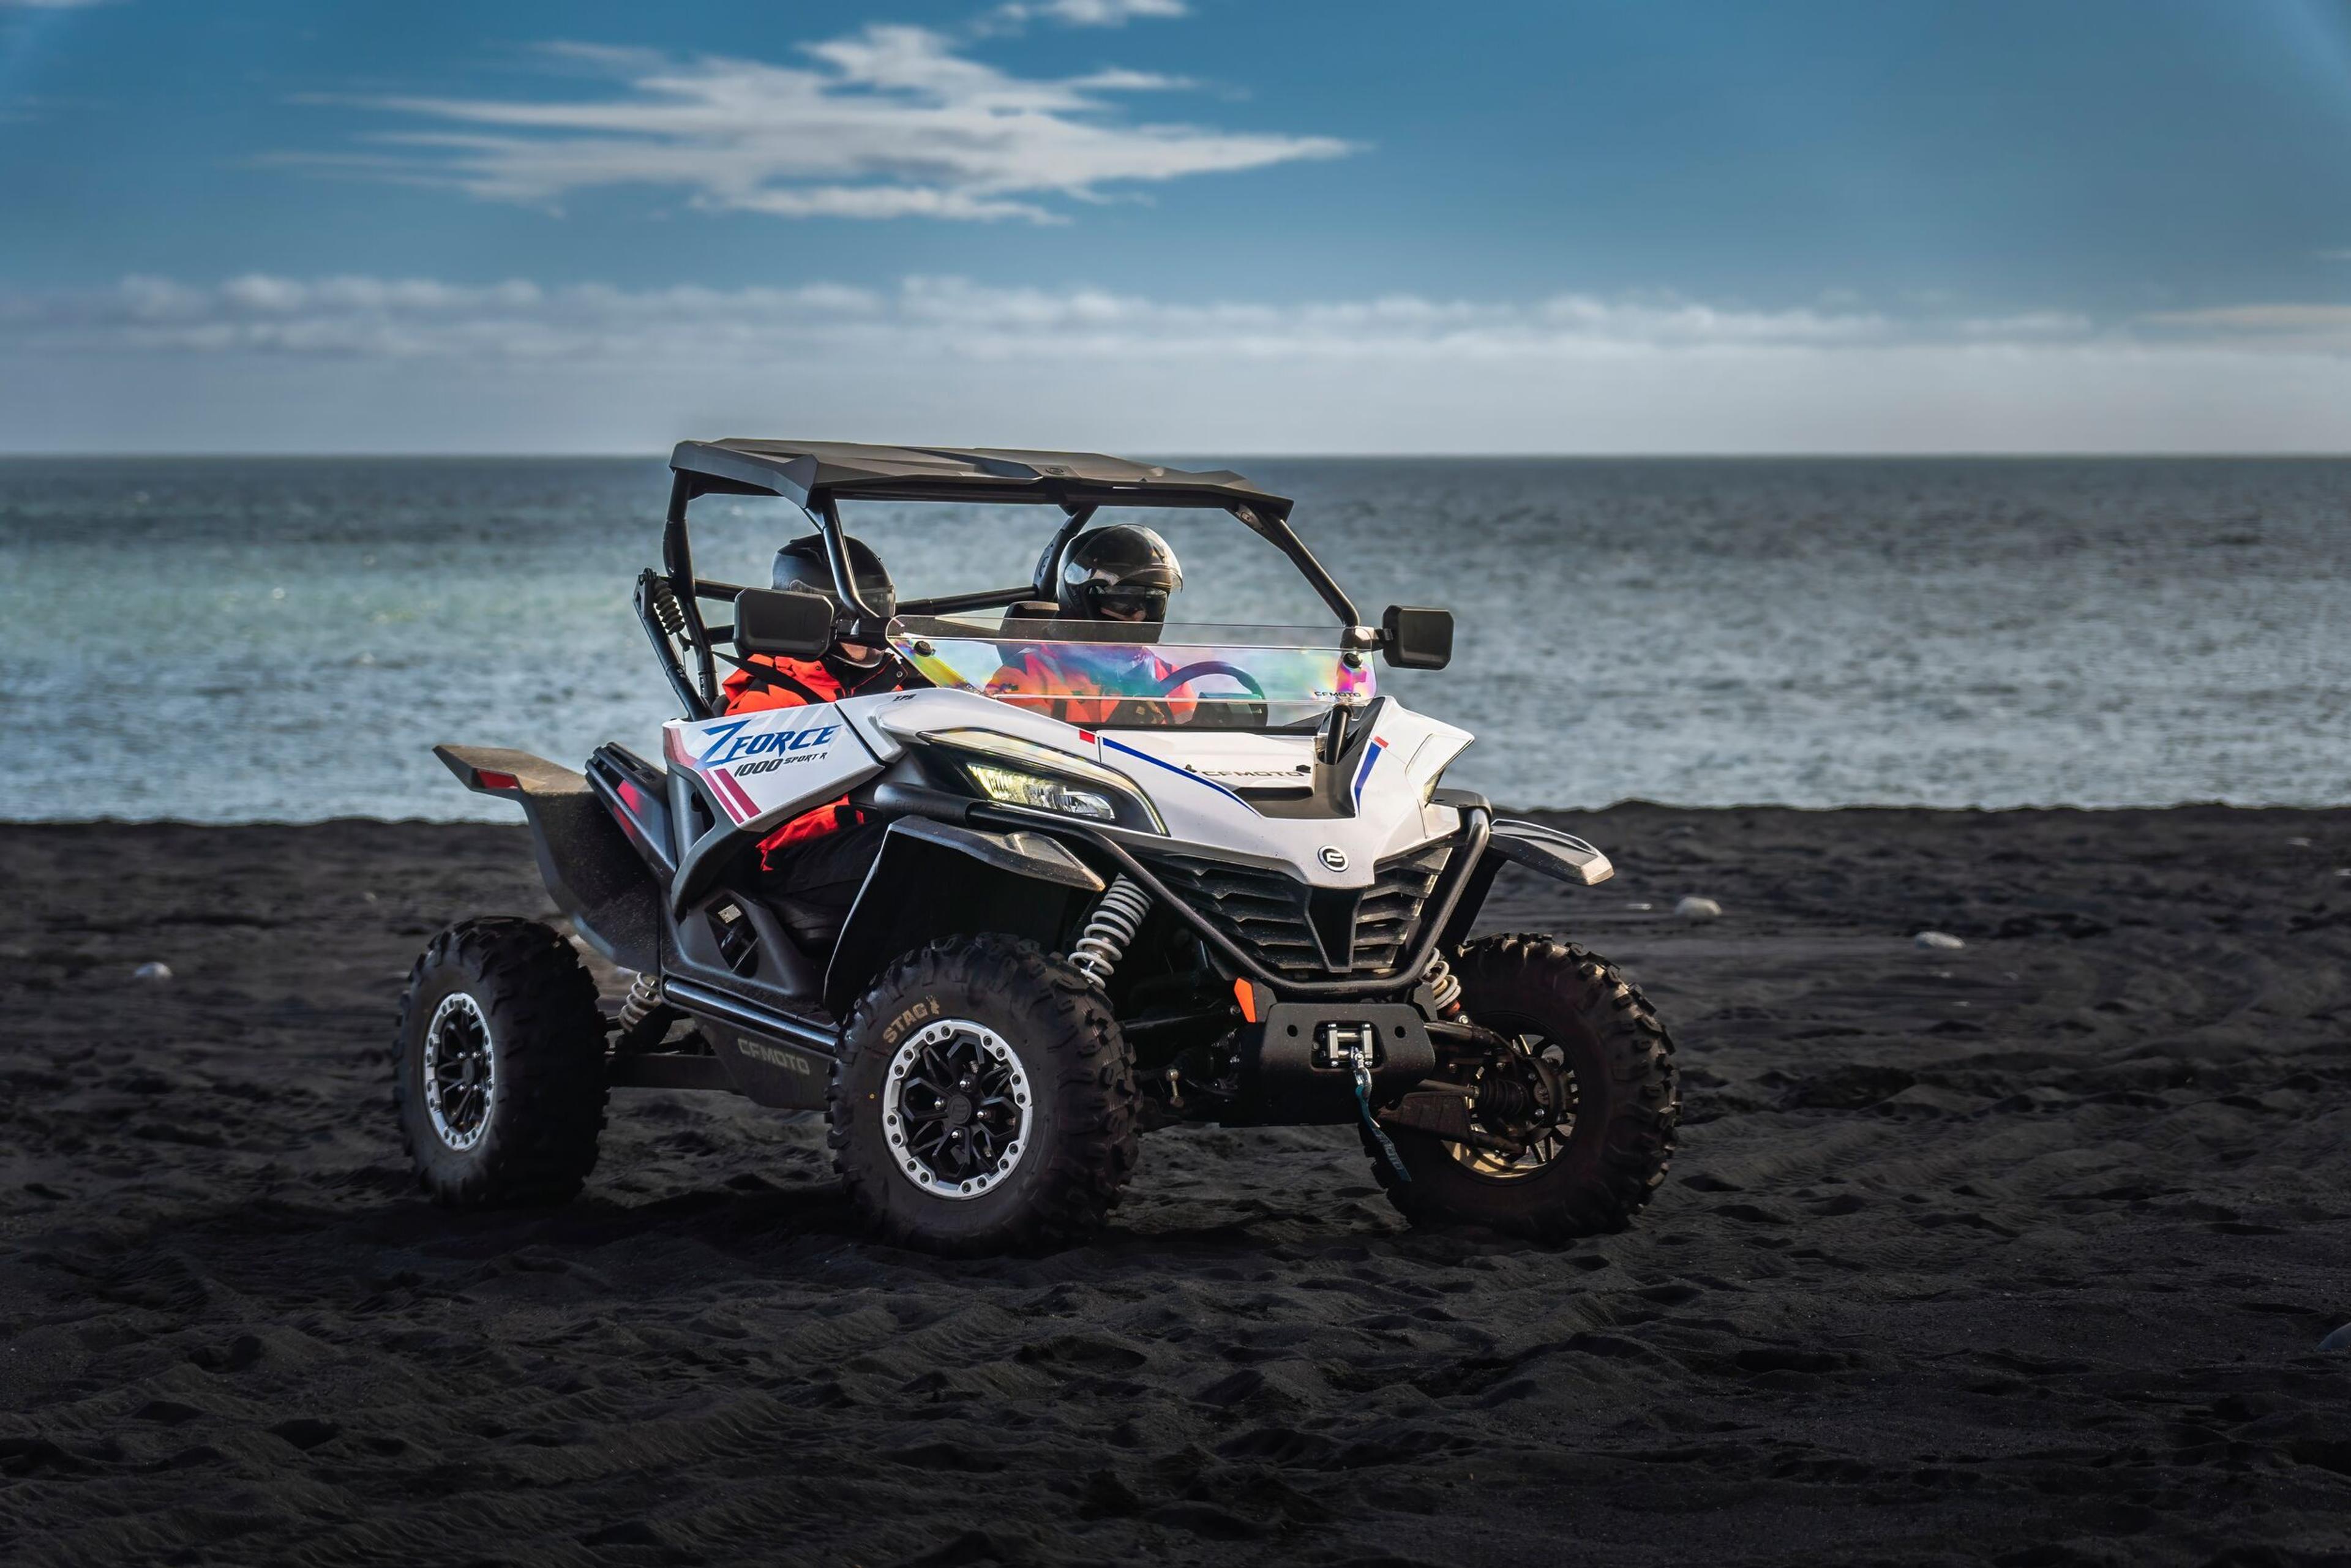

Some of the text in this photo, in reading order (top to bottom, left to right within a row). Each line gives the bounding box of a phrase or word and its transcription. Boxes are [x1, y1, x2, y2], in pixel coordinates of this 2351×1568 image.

[735, 758, 784, 778] 1000
[783, 753, 819, 765] SPORT
[737, 1038, 810, 1075] CFMOTO
